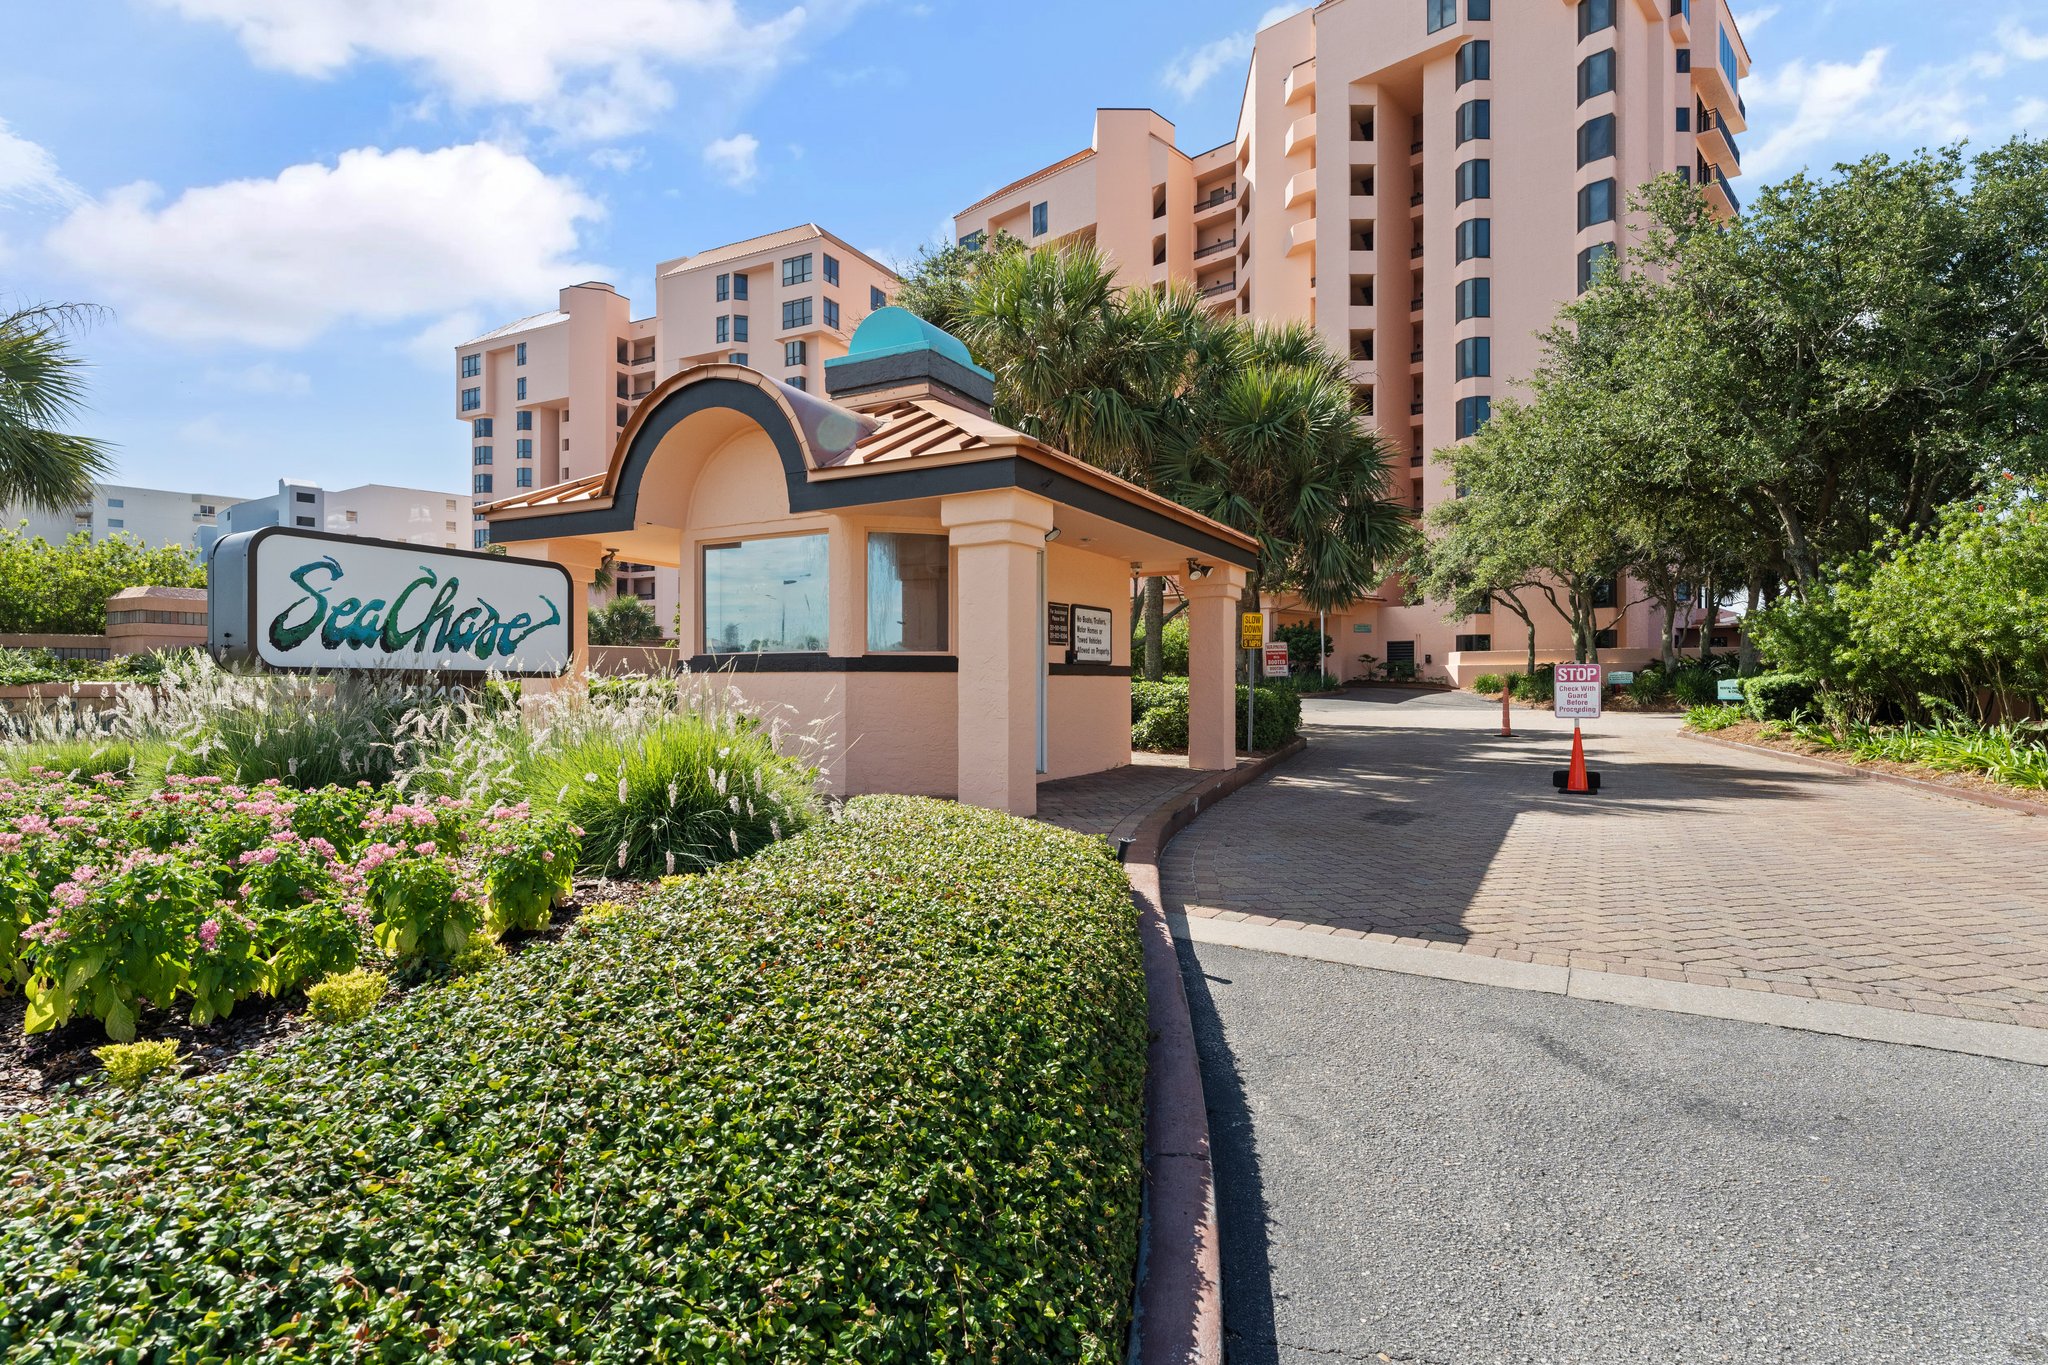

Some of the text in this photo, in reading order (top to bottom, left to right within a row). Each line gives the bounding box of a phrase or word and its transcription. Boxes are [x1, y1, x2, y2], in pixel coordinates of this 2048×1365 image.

[1076, 614, 1081, 623] No
[1245, 615, 1261, 624] SLOW
[1077, 625, 1086, 633] Motor
[1087, 627, 1098, 635] Homes
[1244, 625, 1261, 634] DOWN
[1077, 635, 1087, 644] Towed
[1089, 636, 1102, 645] Vehicles
[1249, 640, 1261, 648] MPH
[1096, 647, 1110, 656] Property
[1558, 667, 1597, 681] STOP
